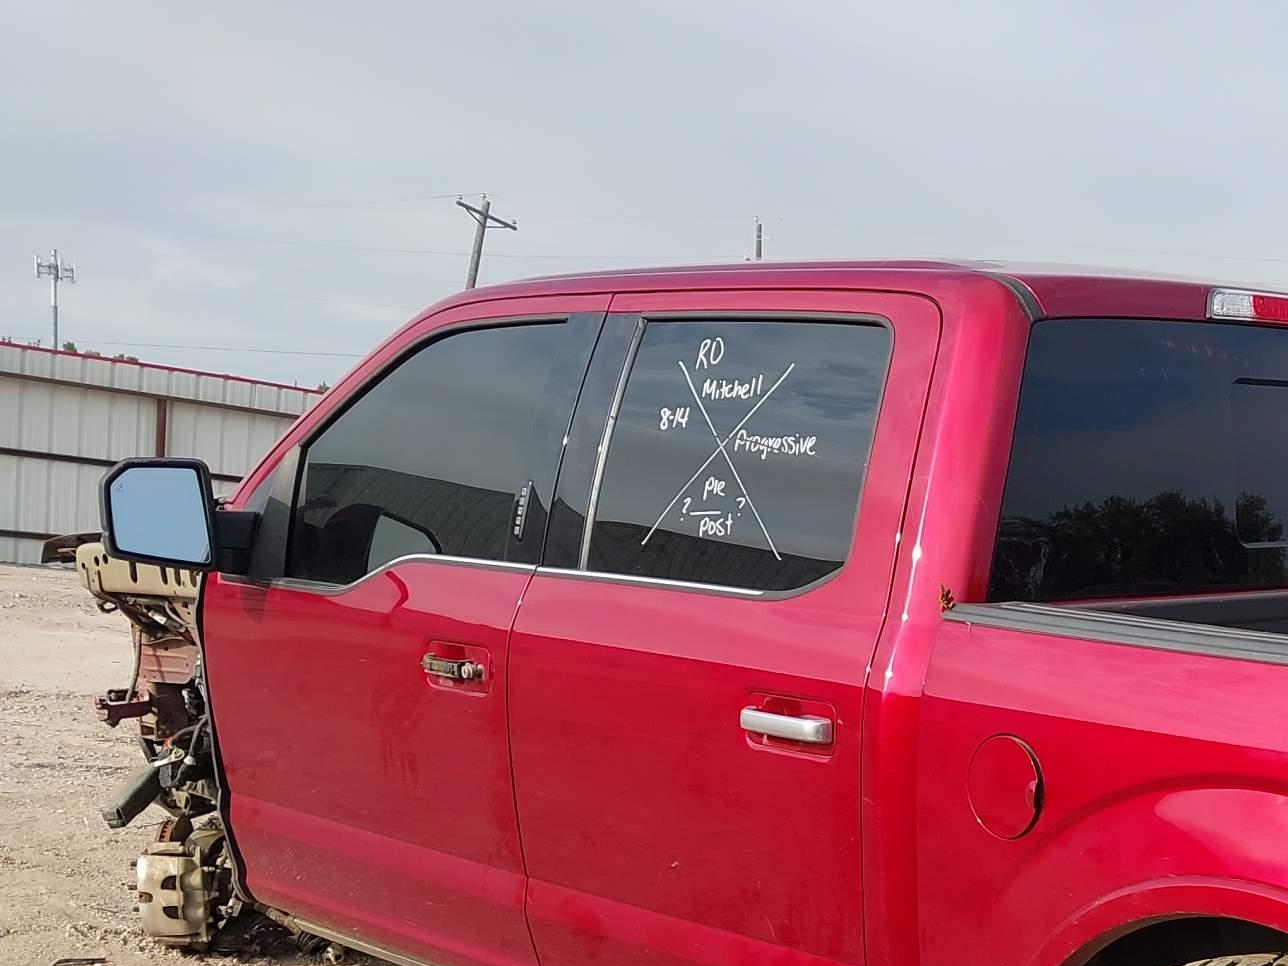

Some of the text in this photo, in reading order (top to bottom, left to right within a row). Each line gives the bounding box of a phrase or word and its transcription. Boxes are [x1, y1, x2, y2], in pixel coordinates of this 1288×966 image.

[696, 337, 724, 369] RO
[702, 375, 763, 400] Mitchell
[660, 407, 690, 430] 8-14
[734, 430, 817, 459] Progressive
